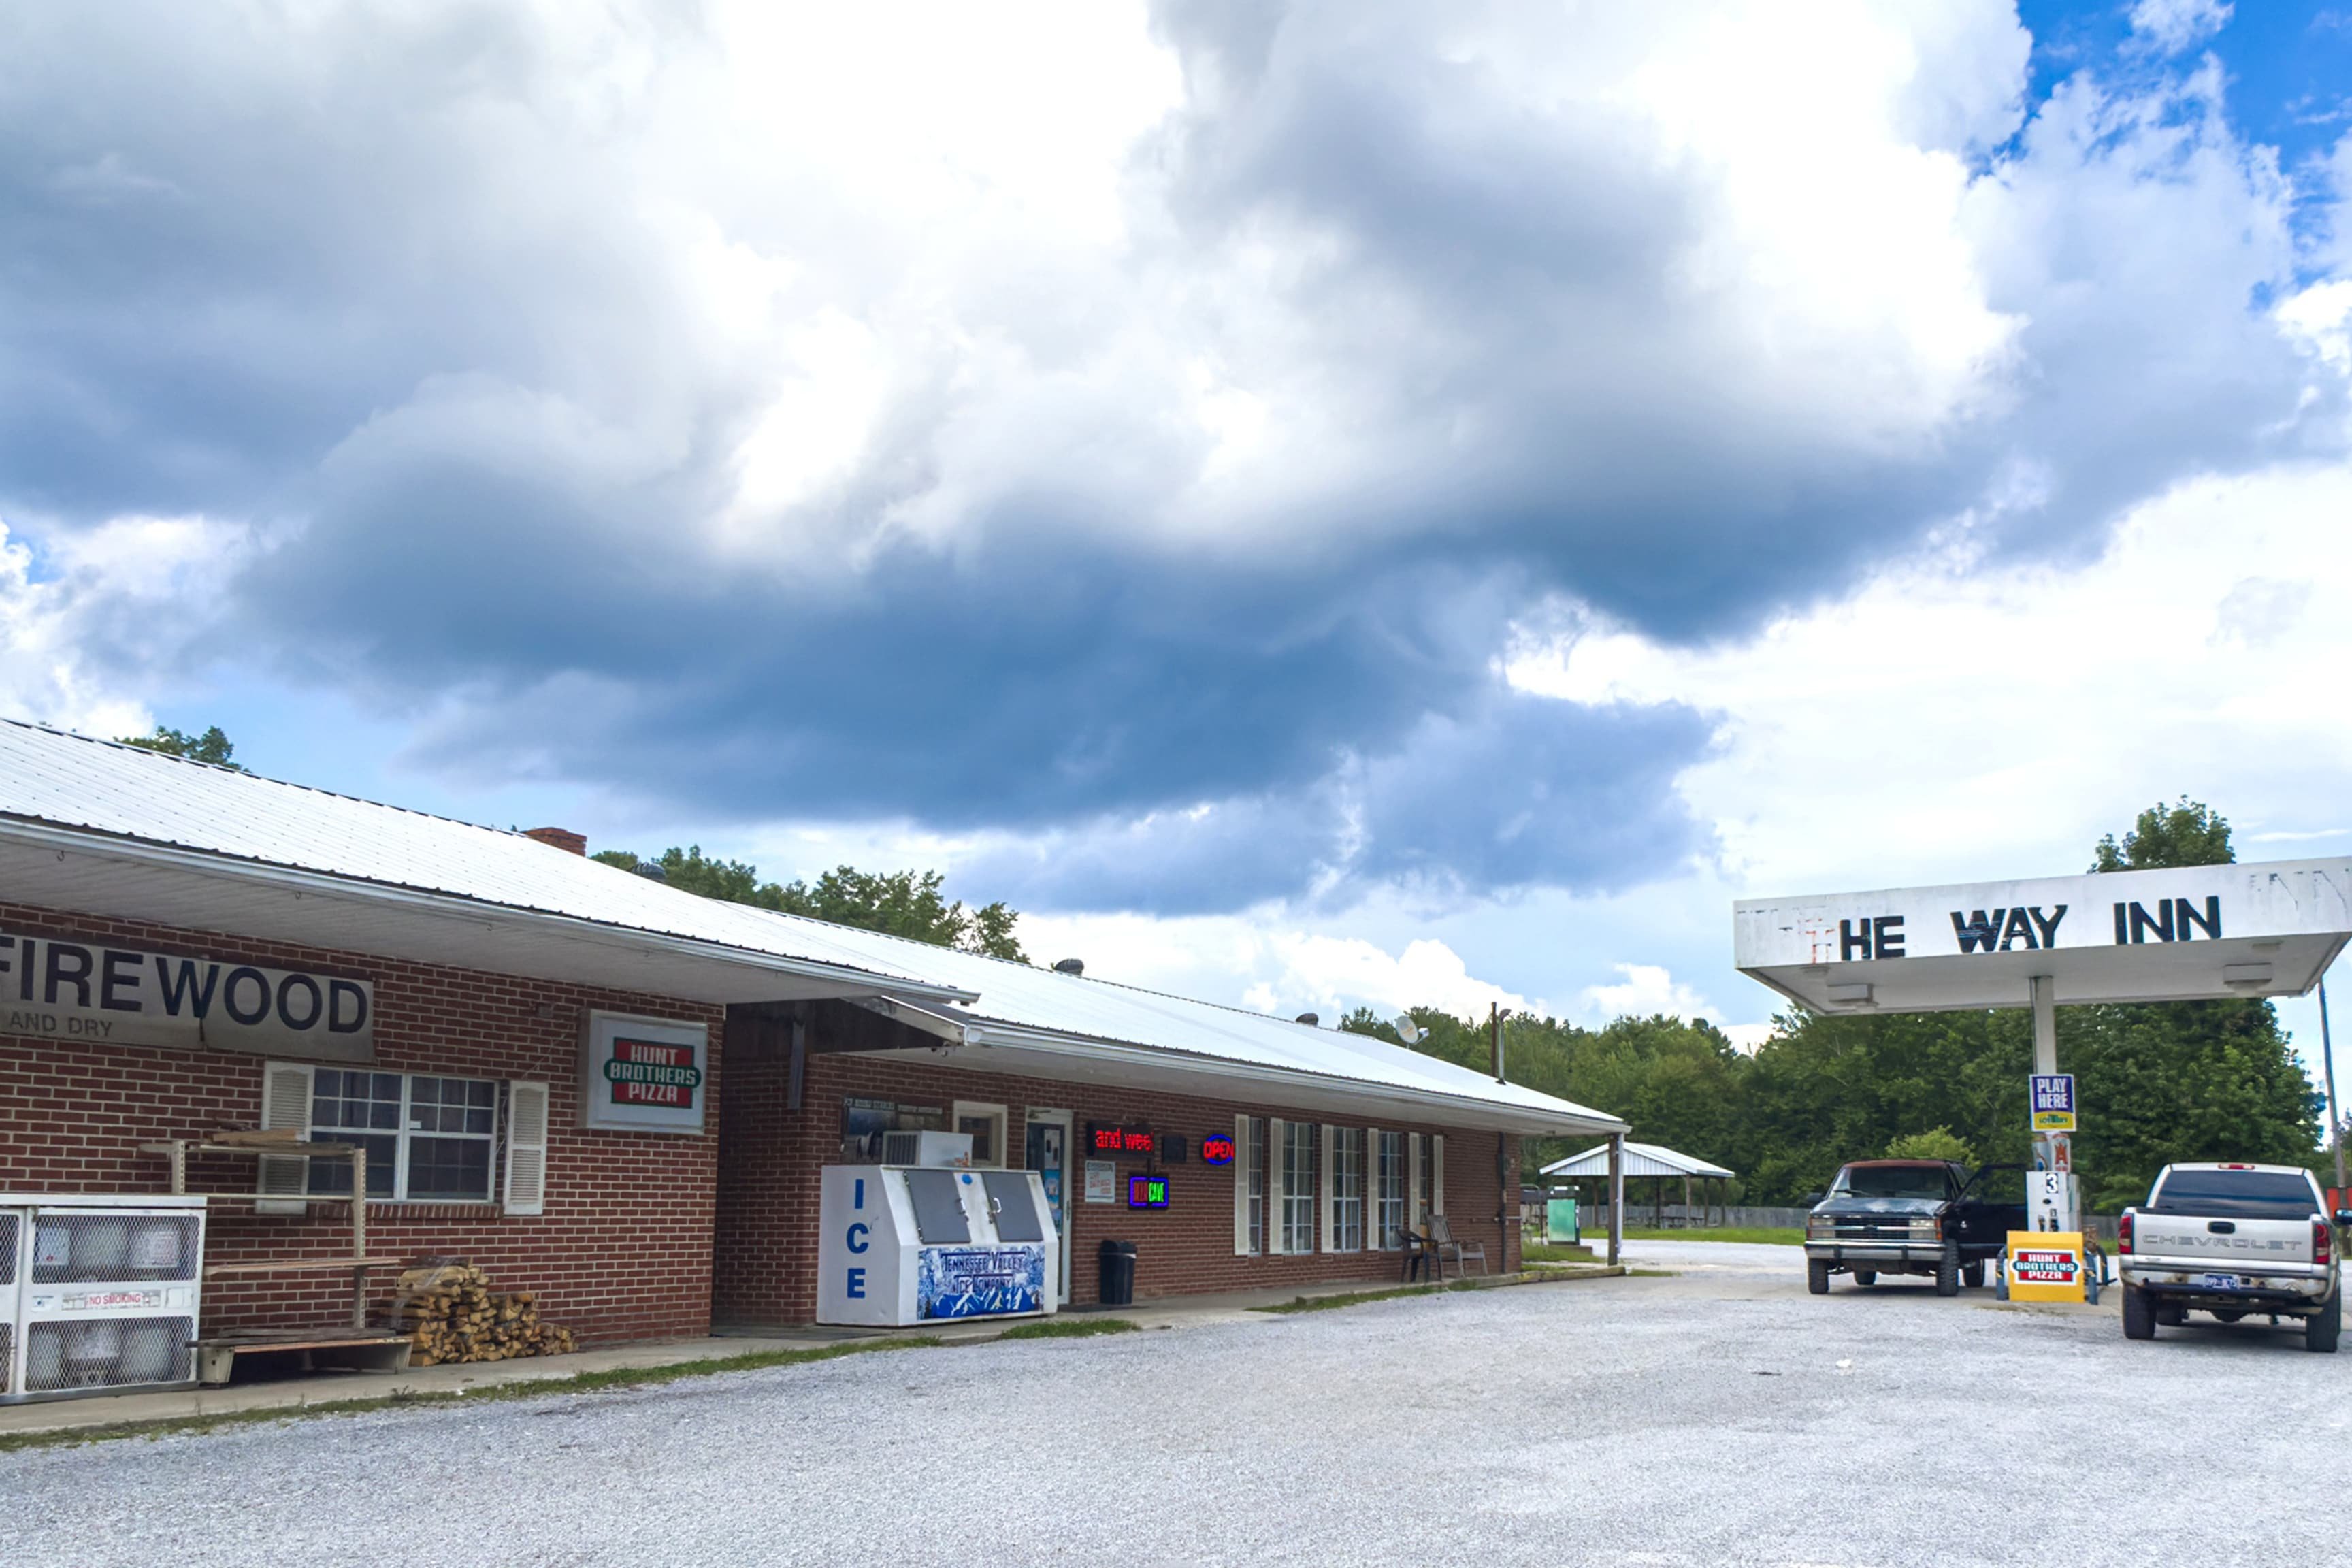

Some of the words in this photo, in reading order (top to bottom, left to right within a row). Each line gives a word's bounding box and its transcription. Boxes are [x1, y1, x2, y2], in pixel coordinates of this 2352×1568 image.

[1950, 904, 2068, 953] WAY
[2114, 896, 2221, 945] INN
[10, 1011, 56, 1032] AND
[69, 1017, 112, 1037] DRY
[630, 1045, 679, 1066] HUNT
[610, 1062, 696, 1085] BROTHERS
[628, 1082, 678, 1102] PIZZA
[2036, 1078, 2066, 1093] PLAY
[2038, 1093, 2068, 1109] HERE
[1095, 1128, 1121, 1149] and
[1203, 1141, 1235, 1160] OPEN
[2046, 1173, 2058, 1194] 3
[846, 1179, 869, 1298] ICE
[2143, 1234, 2302, 1250] CHEVROLET
[2016, 1262, 2075, 1271] BROTHERS
[2028, 1254, 2059, 1262] HUNT
[2028, 1271, 2063, 1279] PIZZA
[89, 1296, 101, 1305] NO
[103, 1294, 142, 1305] SMOKING
